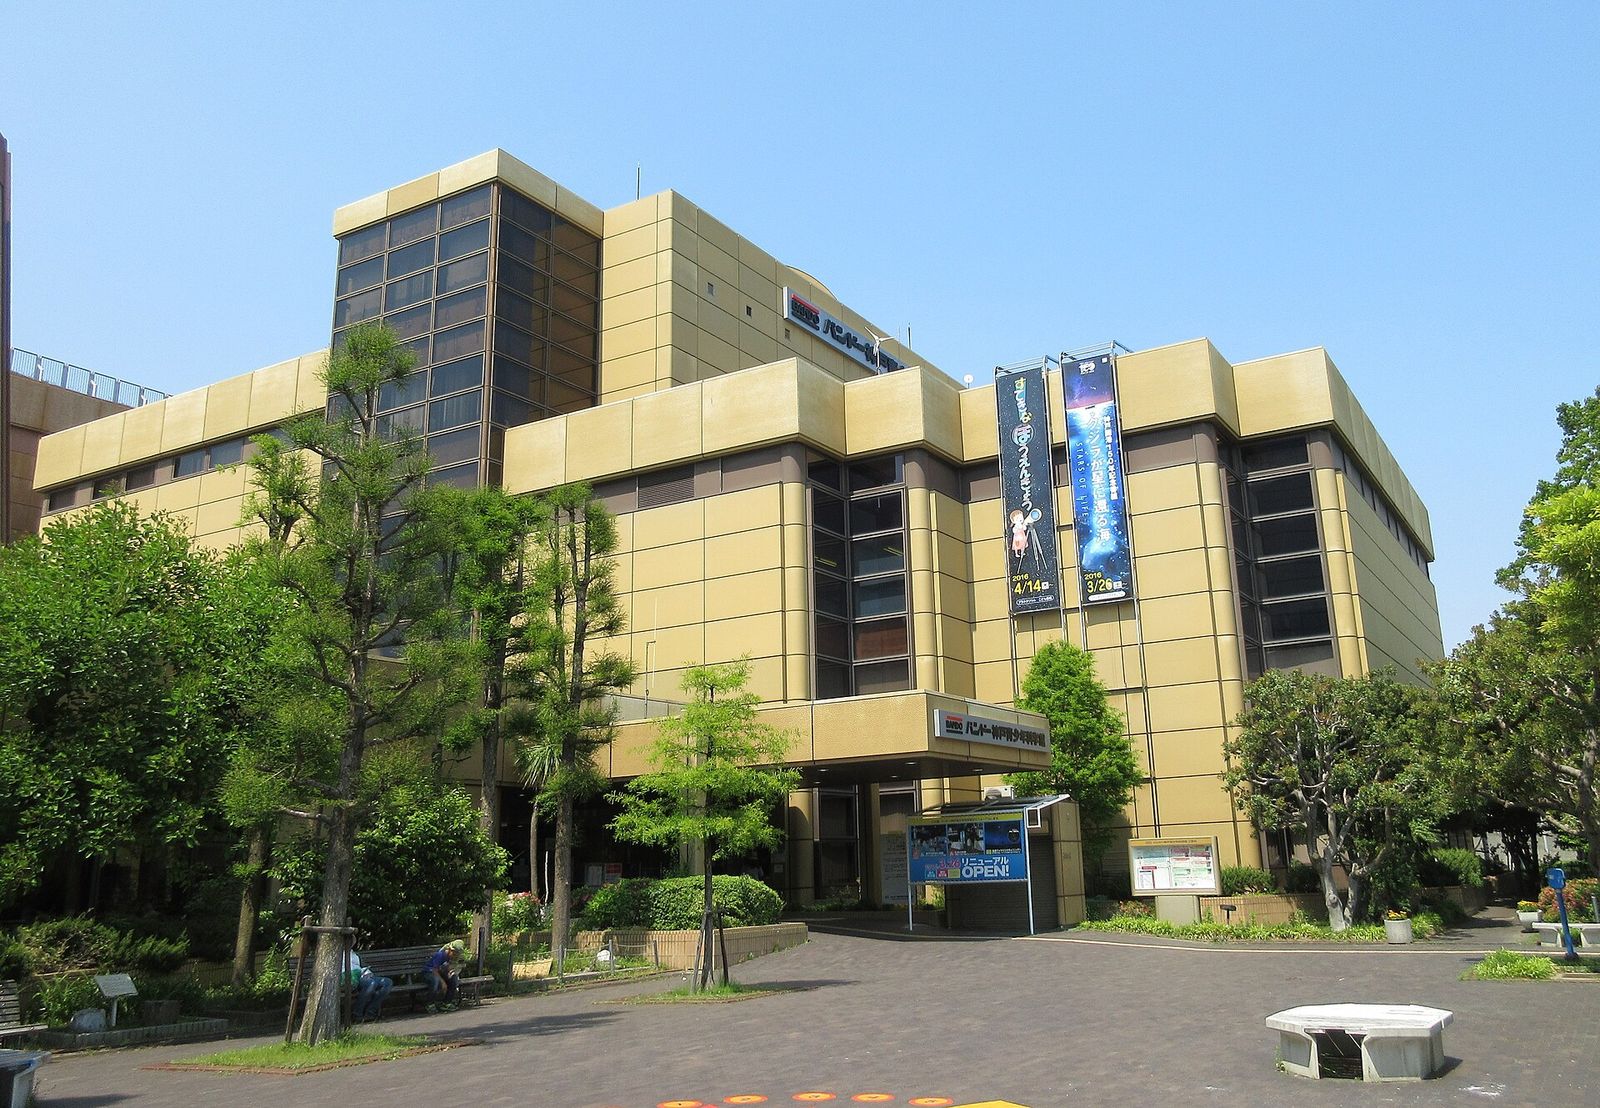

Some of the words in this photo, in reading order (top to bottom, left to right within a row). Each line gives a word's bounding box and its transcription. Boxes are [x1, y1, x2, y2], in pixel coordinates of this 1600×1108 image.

[1075, 442, 1085, 472] STARS
[1079, 477, 1087, 489] OF
[1012, 573, 1029, 582] 2016
[1084, 572, 1102, 580] 2016
[961, 856, 1009, 866] リニューアル
[961, 865, 1010, 878] OPEN!
